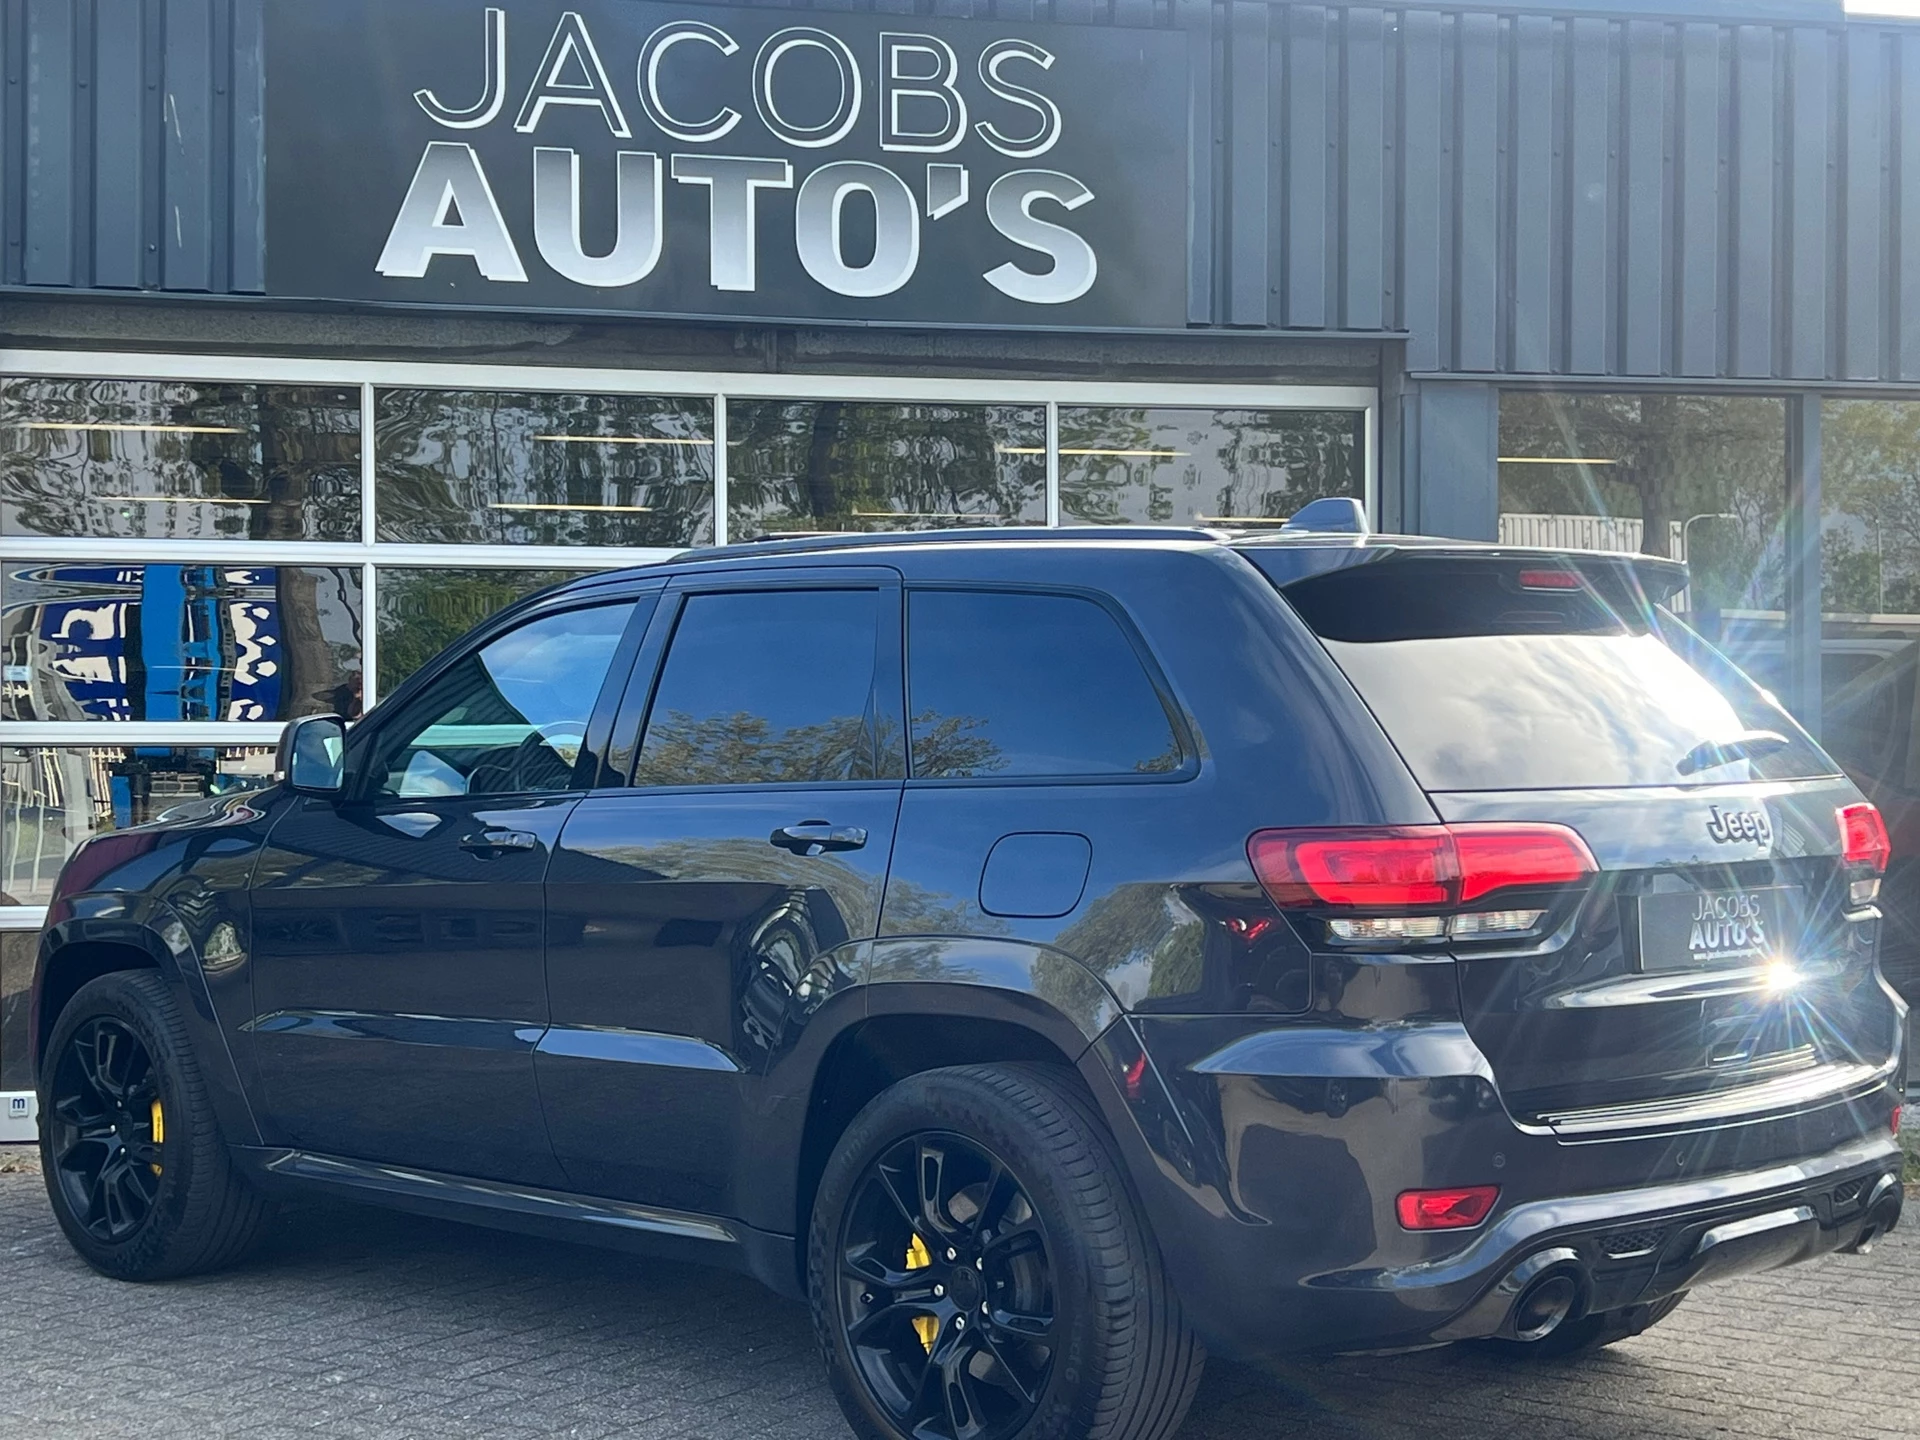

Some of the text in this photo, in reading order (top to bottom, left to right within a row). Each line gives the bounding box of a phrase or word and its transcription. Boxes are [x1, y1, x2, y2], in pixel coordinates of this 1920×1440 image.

[413, 7, 1062, 158] JACOBS
[375, 141, 1098, 304] AUTO'S
[1706, 804, 1773, 846] Jeep
[1691, 894, 1760, 921] JACOBS
[1688, 918, 1765, 949] AUTO'S
